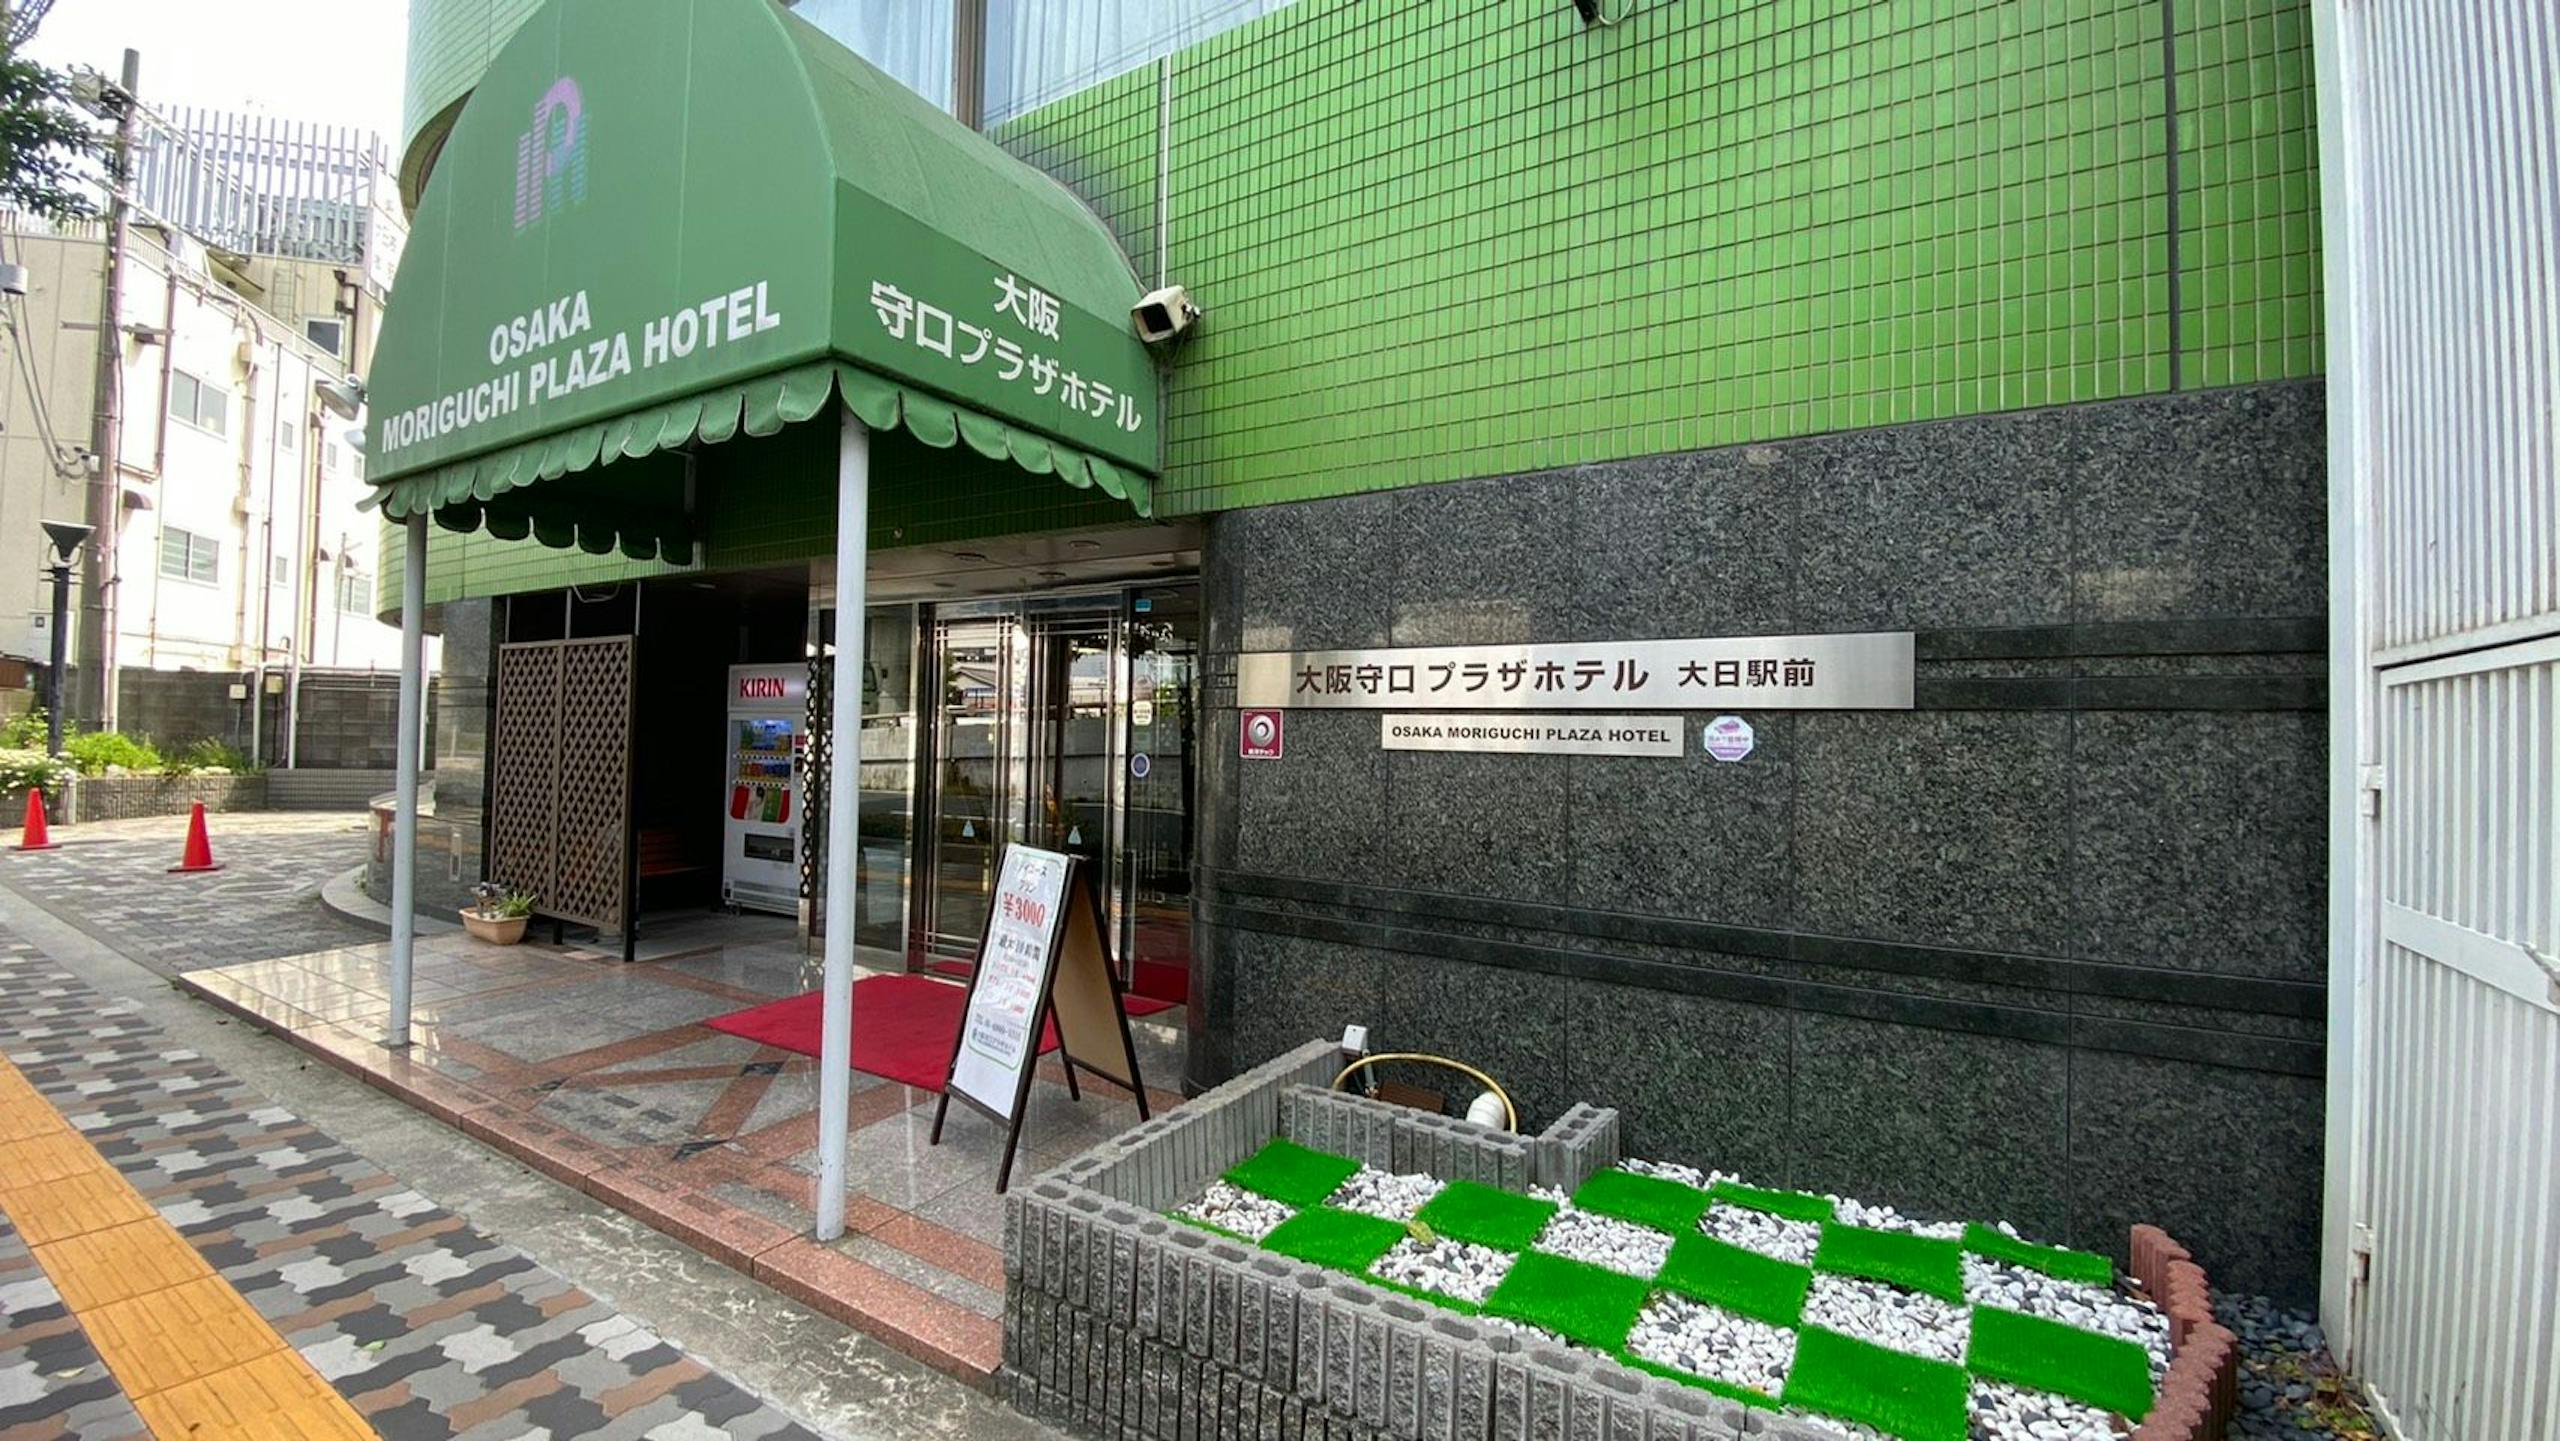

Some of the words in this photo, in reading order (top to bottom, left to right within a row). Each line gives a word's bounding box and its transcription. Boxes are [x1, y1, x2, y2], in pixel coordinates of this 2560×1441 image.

[490, 290, 591, 365] OSAKA
[993, 274, 1061, 342] 大阪
[382, 379, 520, 453] MORIGUCHI
[528, 332, 632, 406] PLAZA
[643, 280, 781, 367] HOTEL
[870, 280, 1142, 432] 守口プラザホテル
[739, 678, 786, 698] KIRIN
[1678, 658, 1816, 688] 大日駅前
[1391, 726, 1443, 738] OSAKA
[1447, 726, 1541, 740] MORIGUCHI
[1546, 728, 1603, 742] PLAZA
[1608, 729, 1671, 742] HOTEL
[1003, 891, 1046, 928] ¥3000
